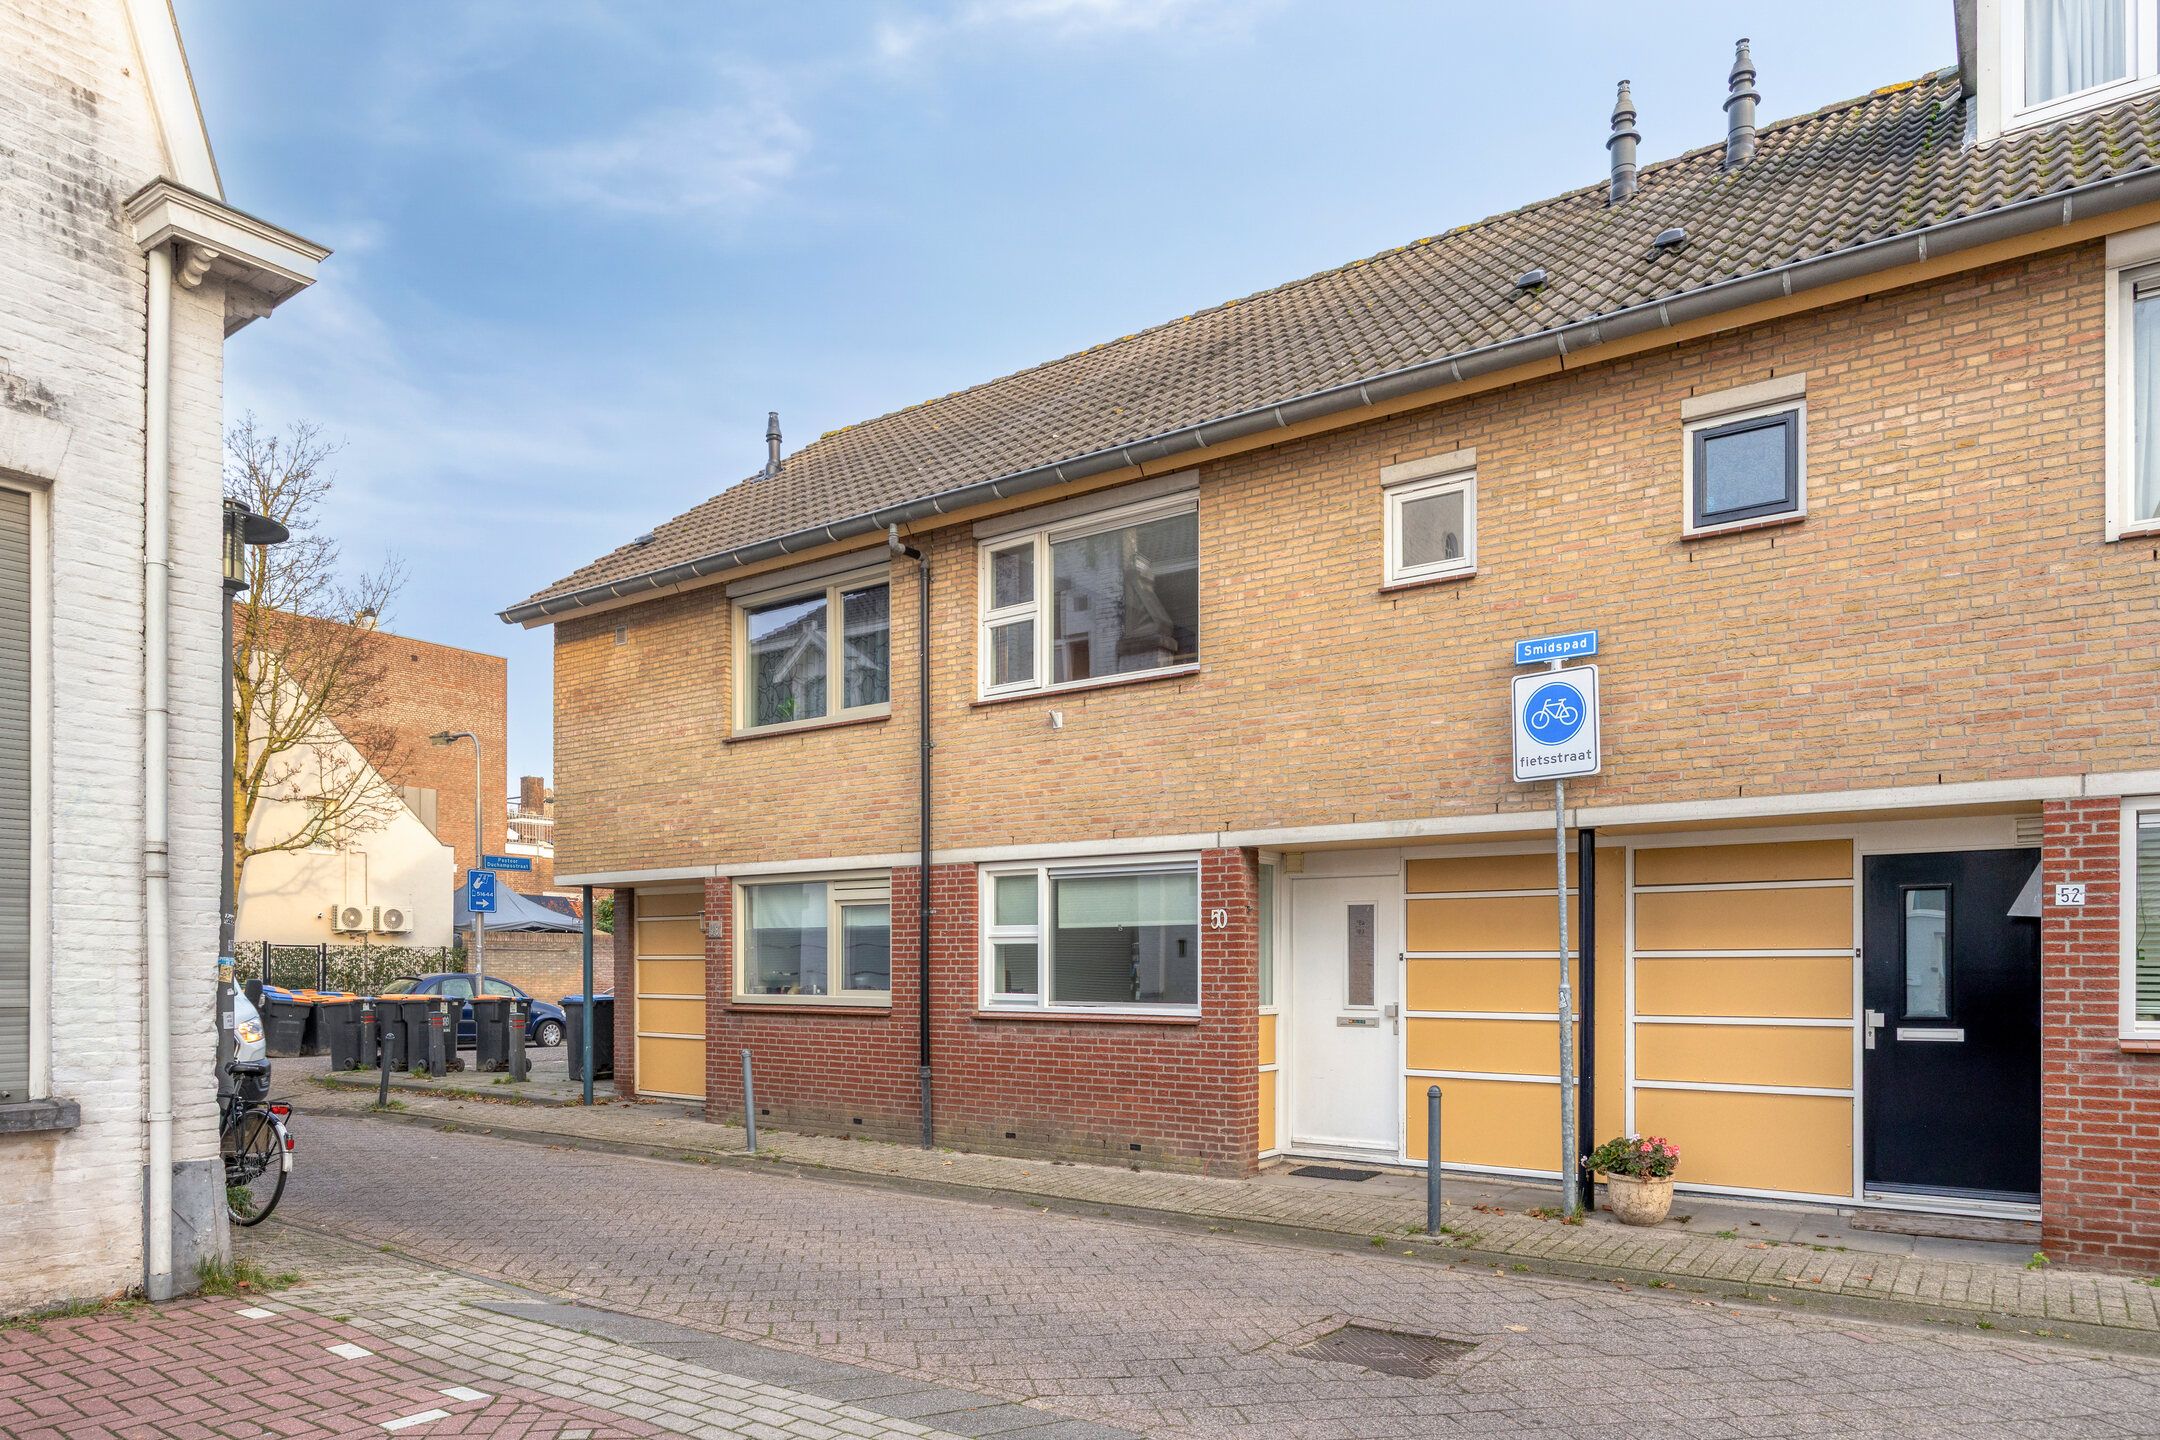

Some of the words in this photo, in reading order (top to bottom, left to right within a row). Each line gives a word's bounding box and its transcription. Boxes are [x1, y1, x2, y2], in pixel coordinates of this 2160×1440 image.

[1524, 637, 1587, 656] Smidspad
[1520, 749, 1592, 767] fietsstraat
[2061, 887, 2080, 903] 52
[1211, 909, 1227, 929] 50
